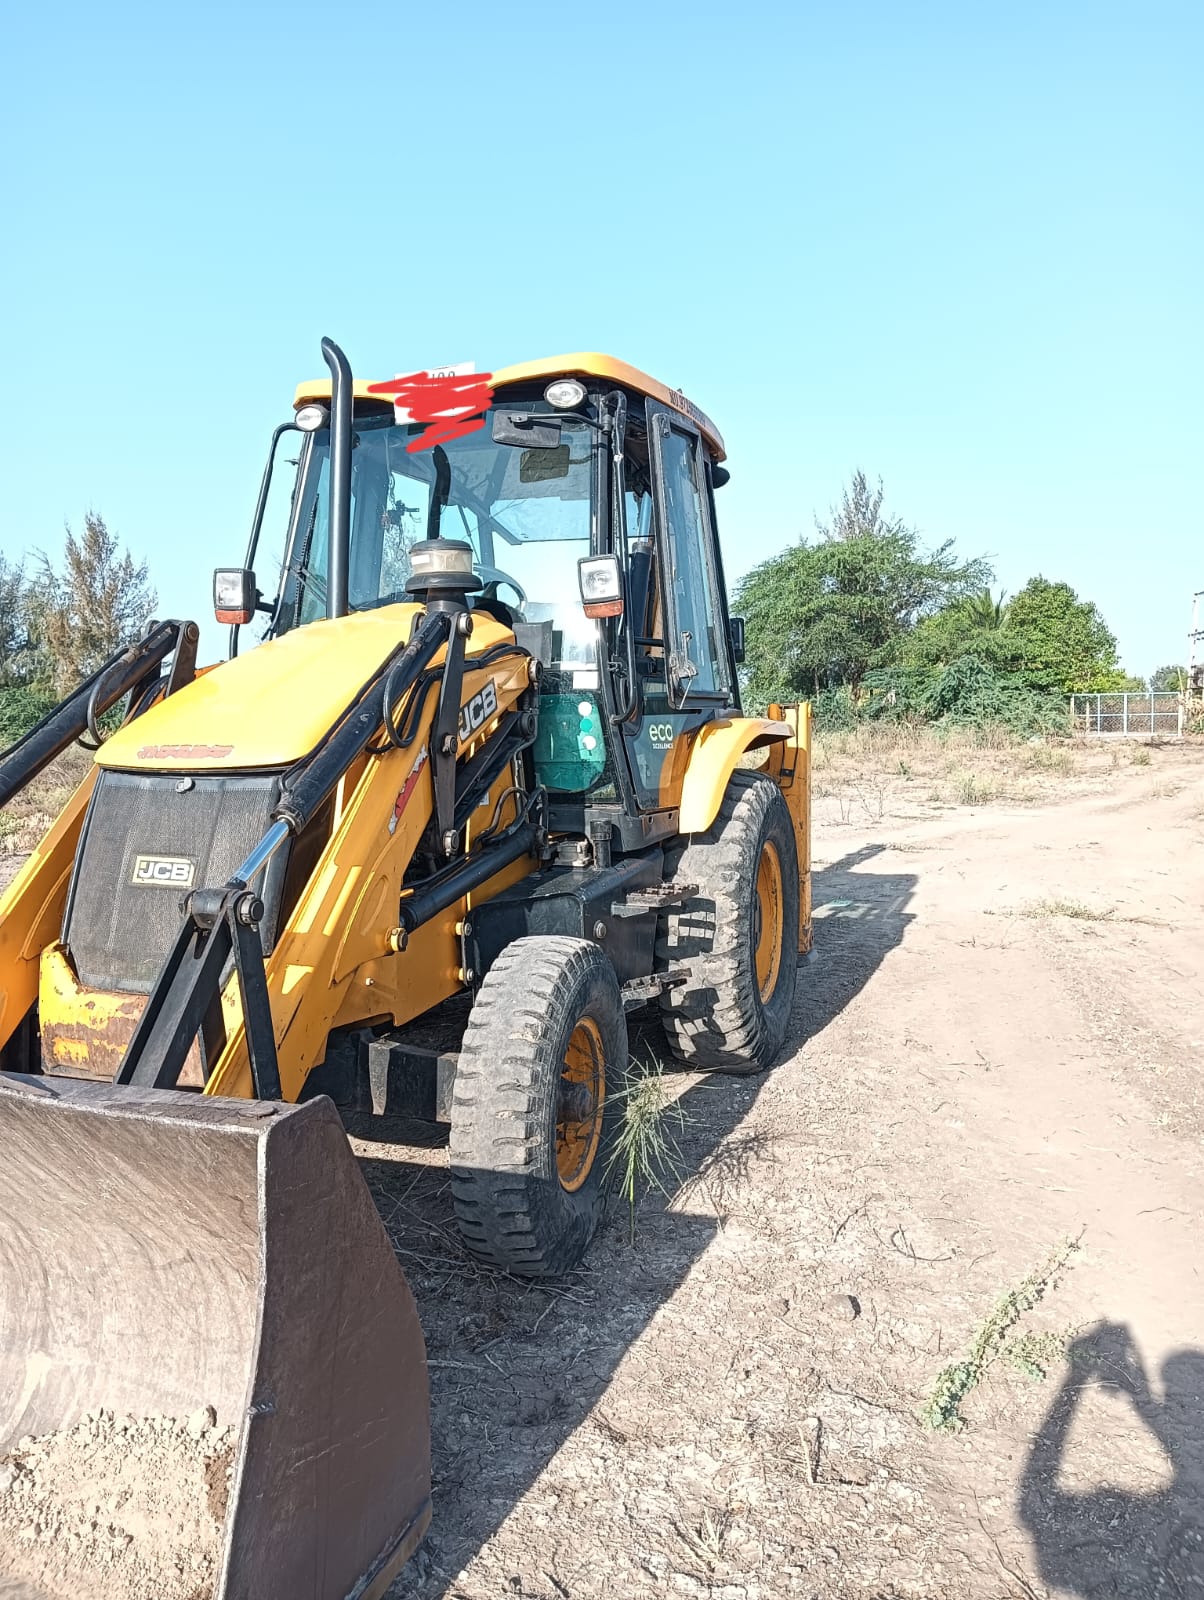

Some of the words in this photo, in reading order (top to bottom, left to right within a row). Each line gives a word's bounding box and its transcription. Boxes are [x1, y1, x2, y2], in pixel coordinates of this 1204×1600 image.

[458, 683, 497, 741] JCB
[649, 724, 674, 742] eco
[138, 861, 191, 881] JCB
